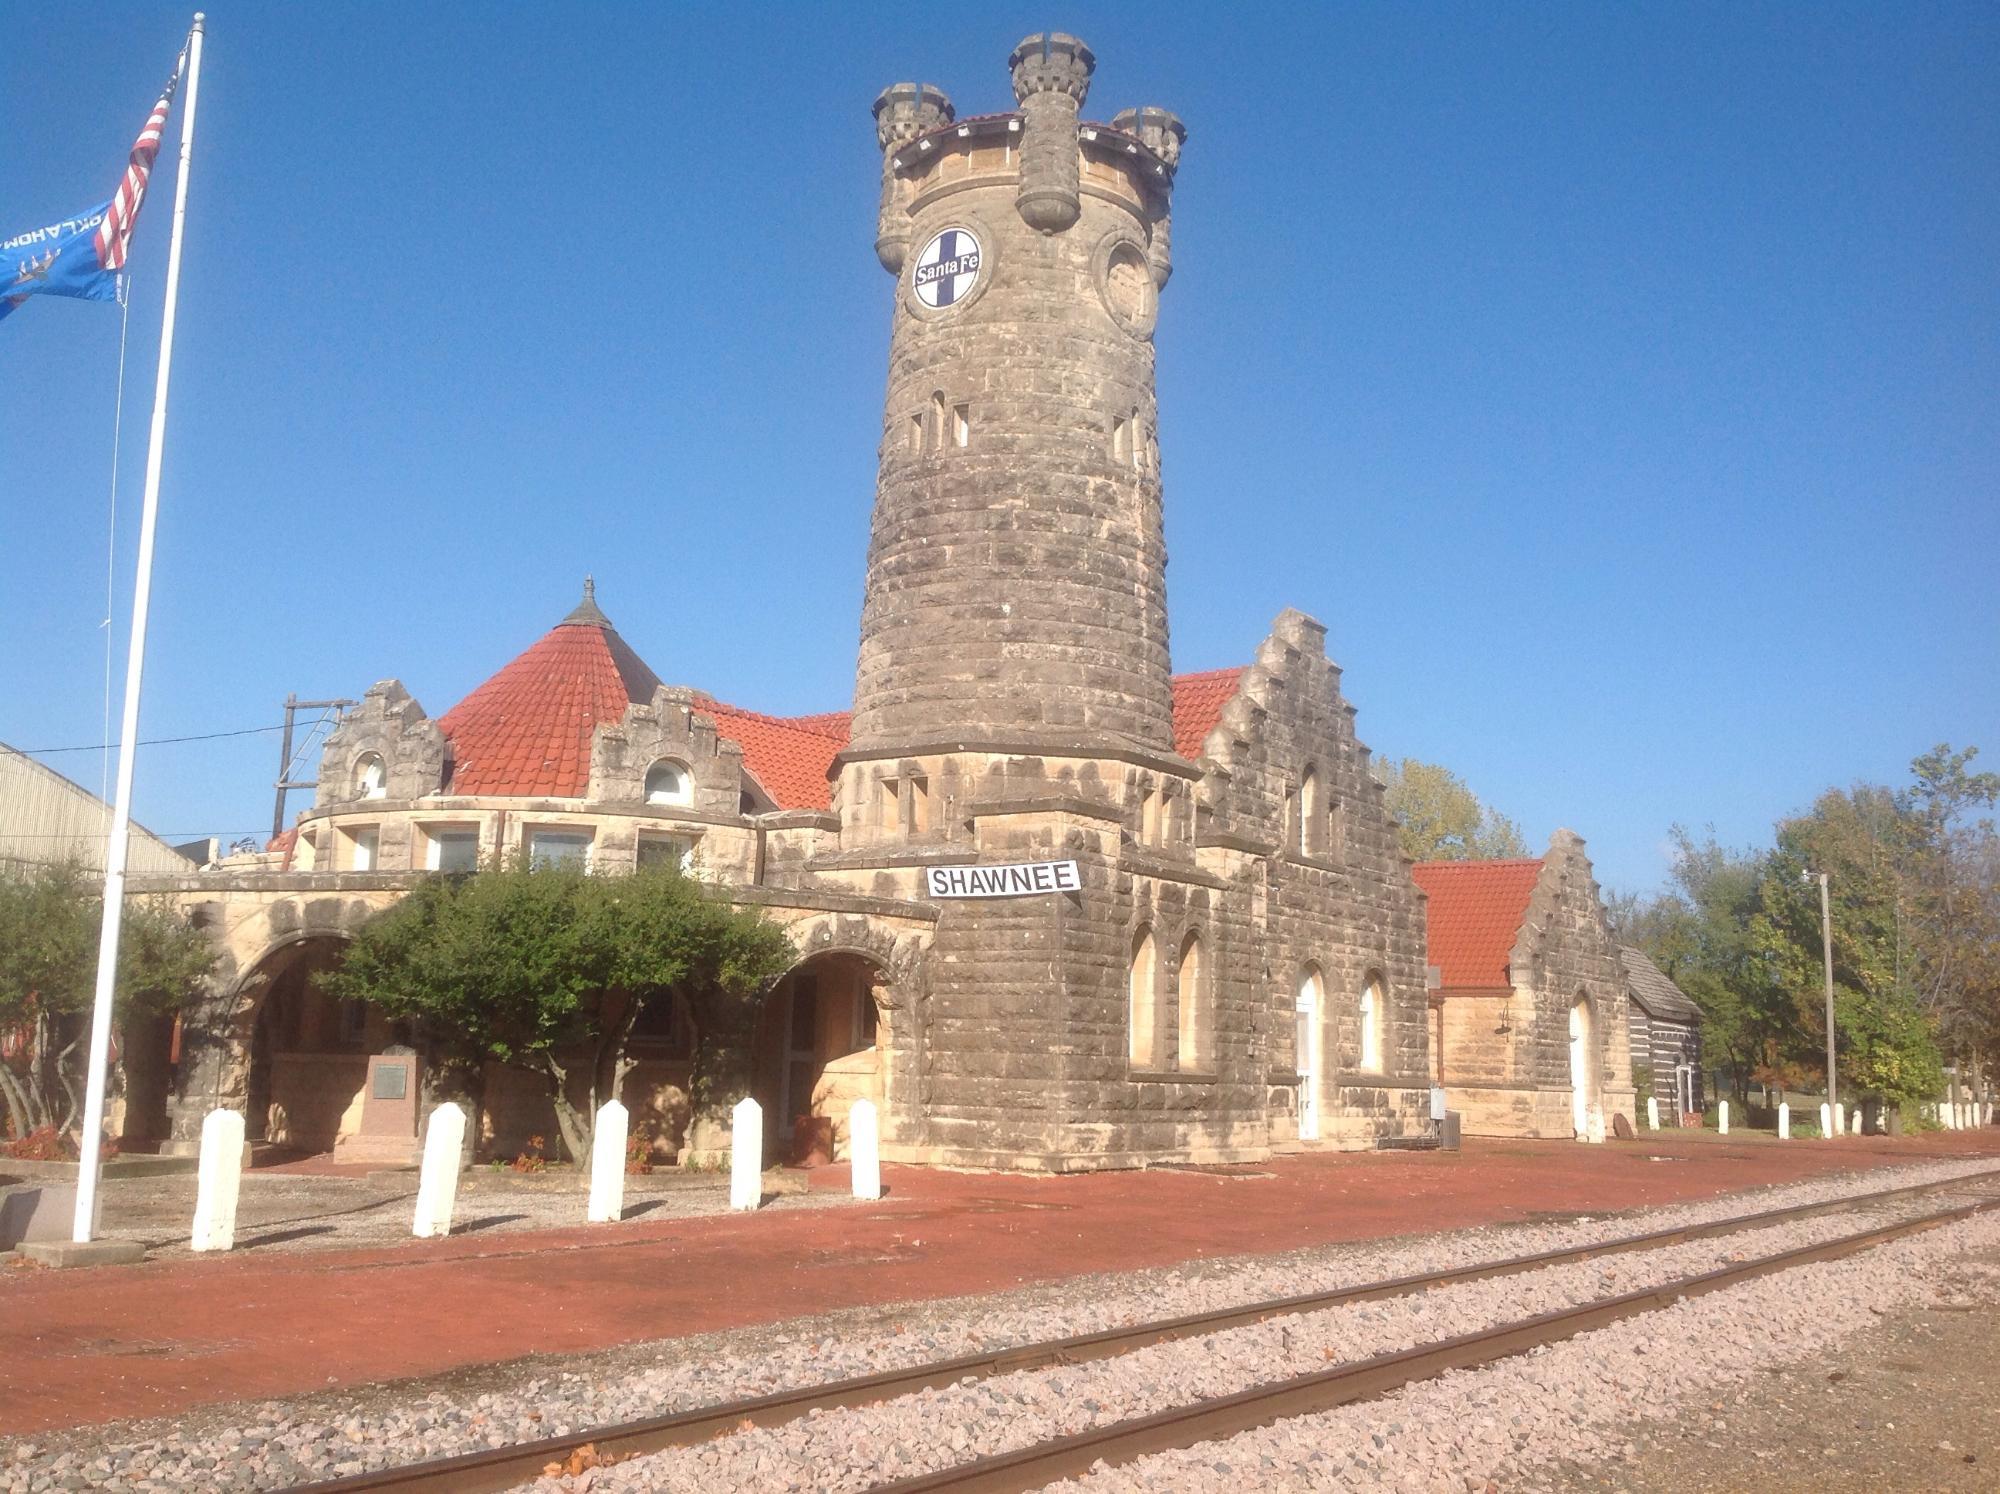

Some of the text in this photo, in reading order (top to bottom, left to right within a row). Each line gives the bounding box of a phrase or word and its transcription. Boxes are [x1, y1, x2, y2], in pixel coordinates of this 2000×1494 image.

[0, 215, 101, 249] OKLAHOM
[916, 255, 978, 284] Santa Fe
[933, 863, 1074, 894] SHAWNEE
